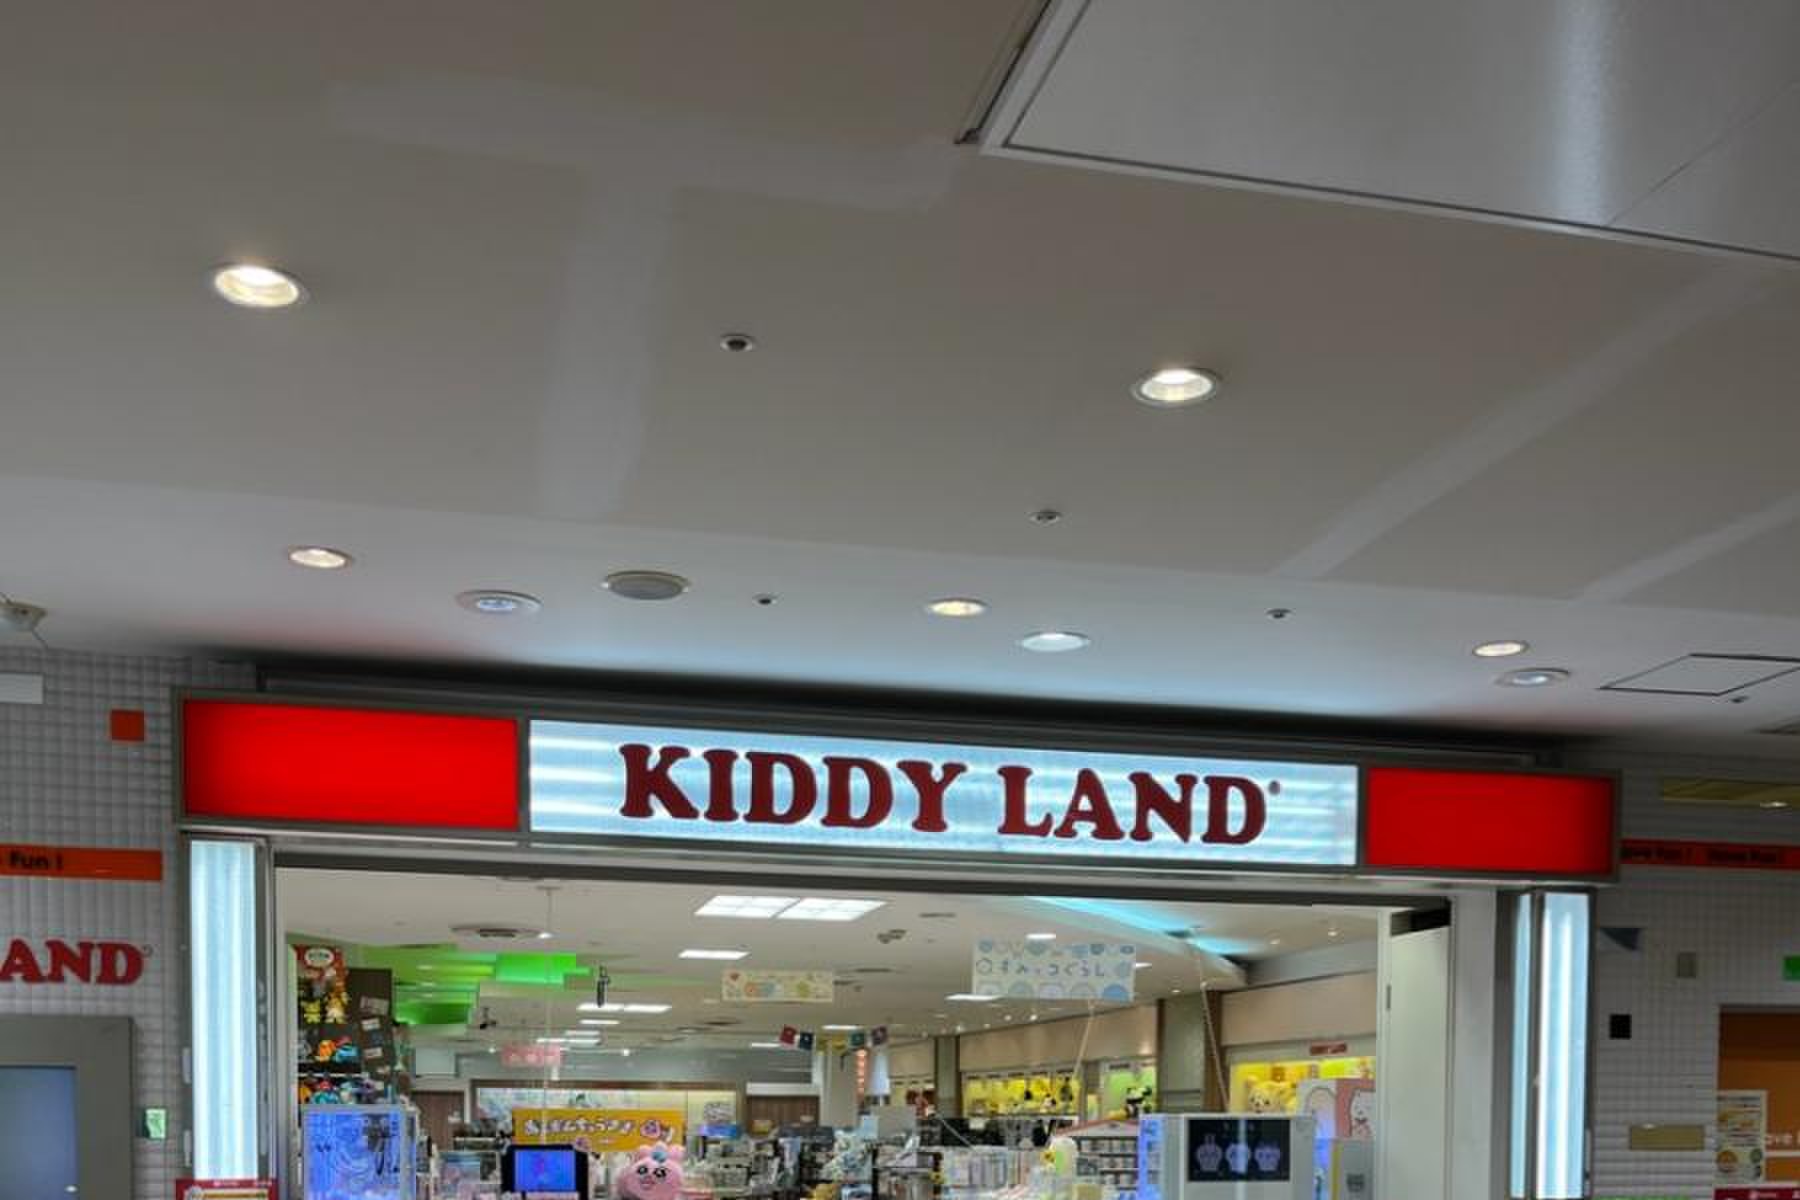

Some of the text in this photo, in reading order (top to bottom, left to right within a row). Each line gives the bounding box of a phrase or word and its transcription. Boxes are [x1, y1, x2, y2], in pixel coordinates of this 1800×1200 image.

[619, 744, 1267, 845] KIDDY LAND
[9, 850, 50, 869] Fun
